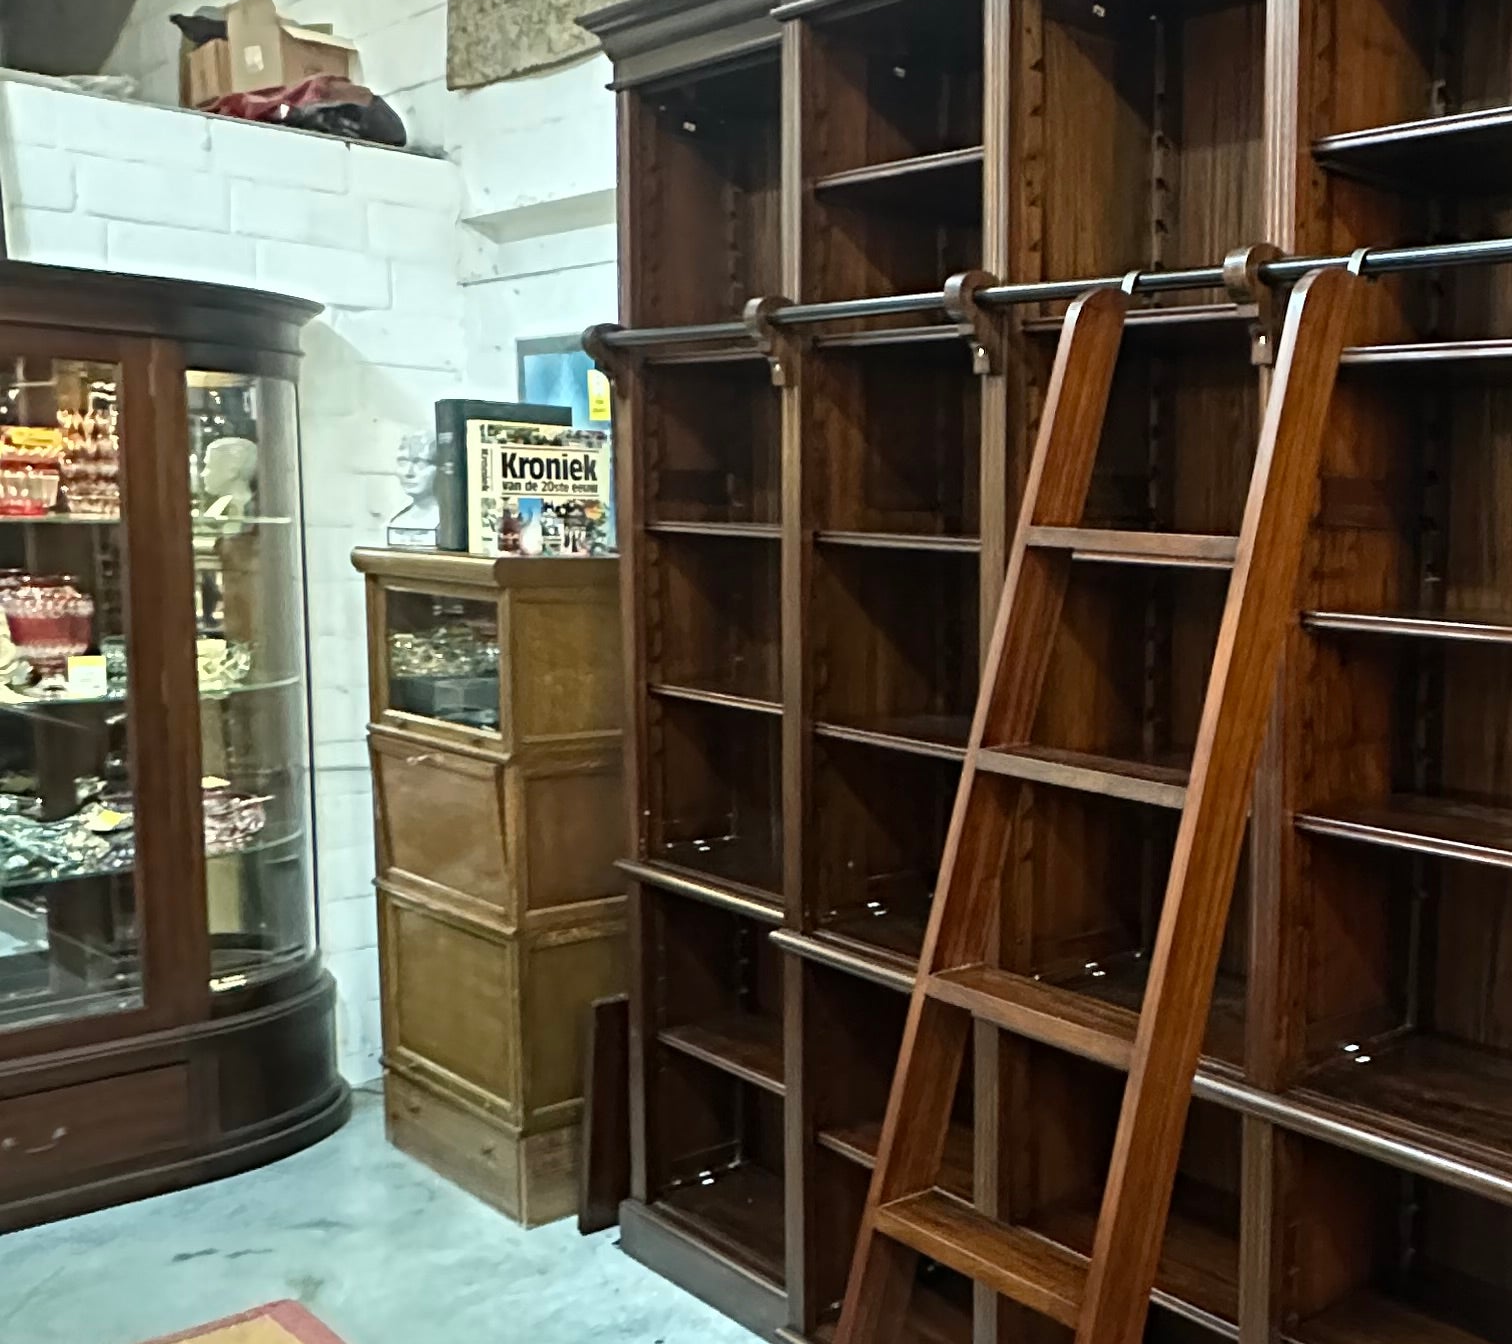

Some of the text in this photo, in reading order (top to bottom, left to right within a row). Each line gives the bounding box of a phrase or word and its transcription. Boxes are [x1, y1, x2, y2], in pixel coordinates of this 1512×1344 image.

[501, 452, 598, 481] Kroniek
[502, 481, 598, 493] van de 20ste eeuw
